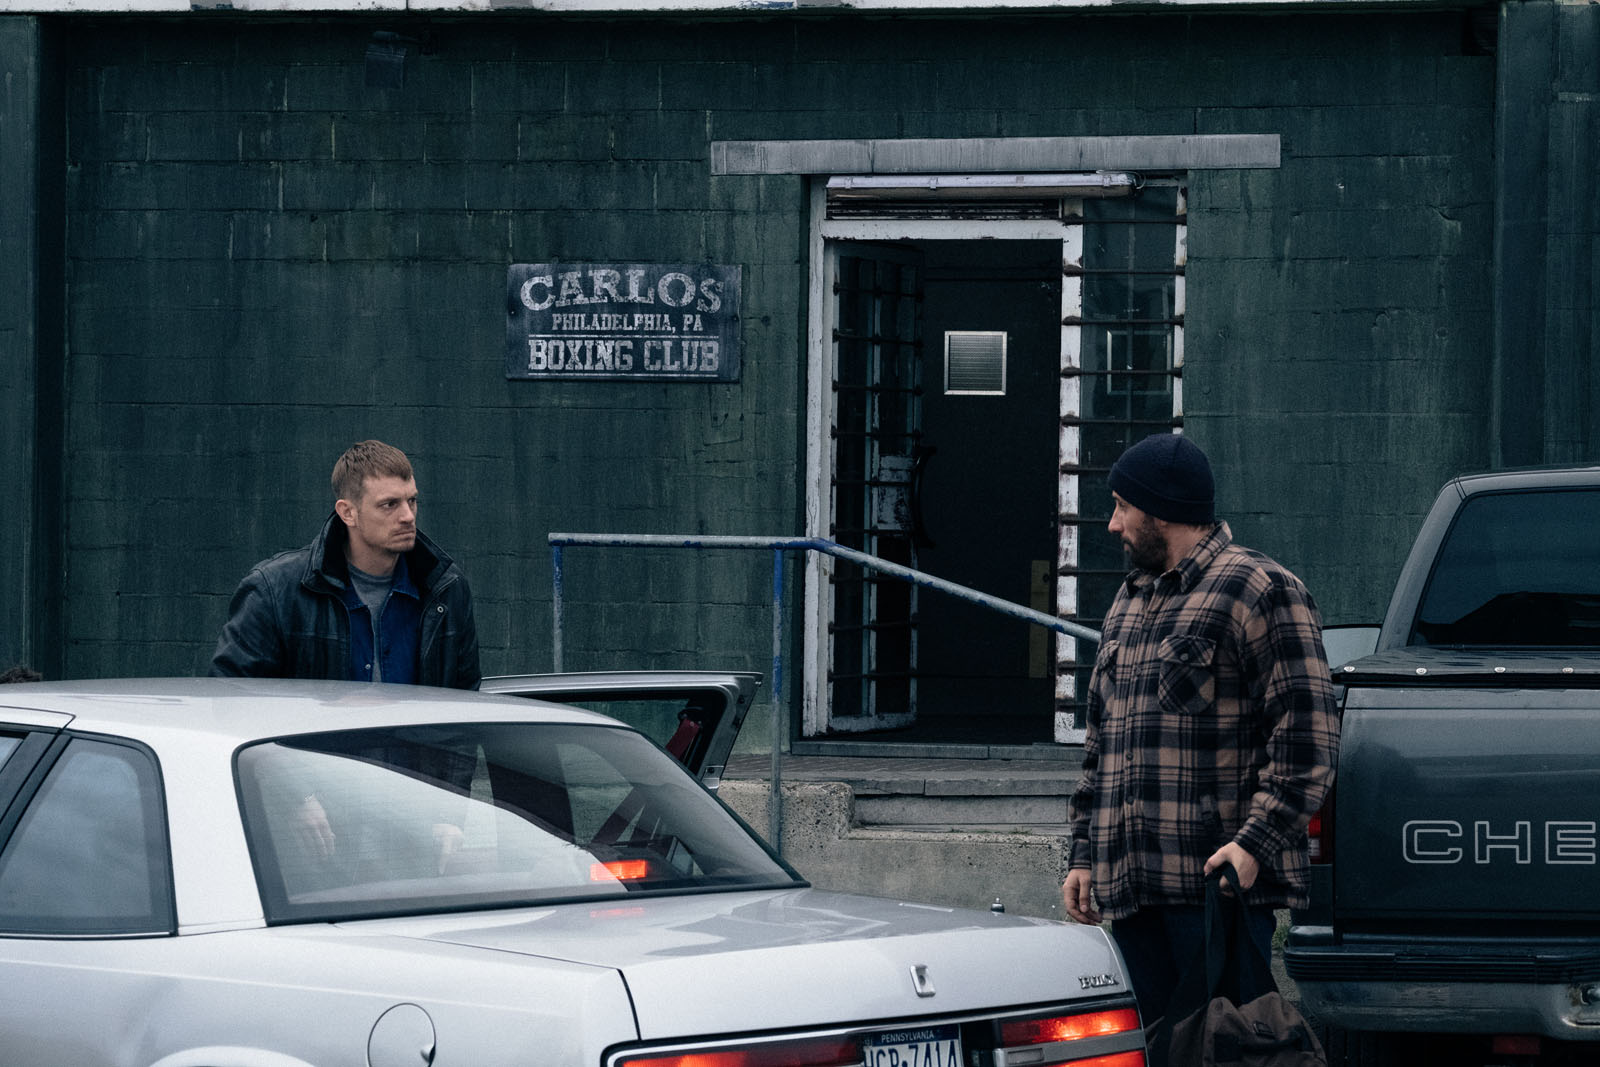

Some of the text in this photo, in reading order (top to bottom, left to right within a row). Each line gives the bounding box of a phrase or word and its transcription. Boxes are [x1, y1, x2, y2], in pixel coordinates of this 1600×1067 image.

[520, 269, 725, 314] CARLOS
[551, 313, 704, 334] PHILADELPHIA, PA
[528, 339, 720, 372] BOXING CLUB
[1402, 820, 1597, 864] CHE
[881, 1030, 935, 1043] PENNSYLVANIA
